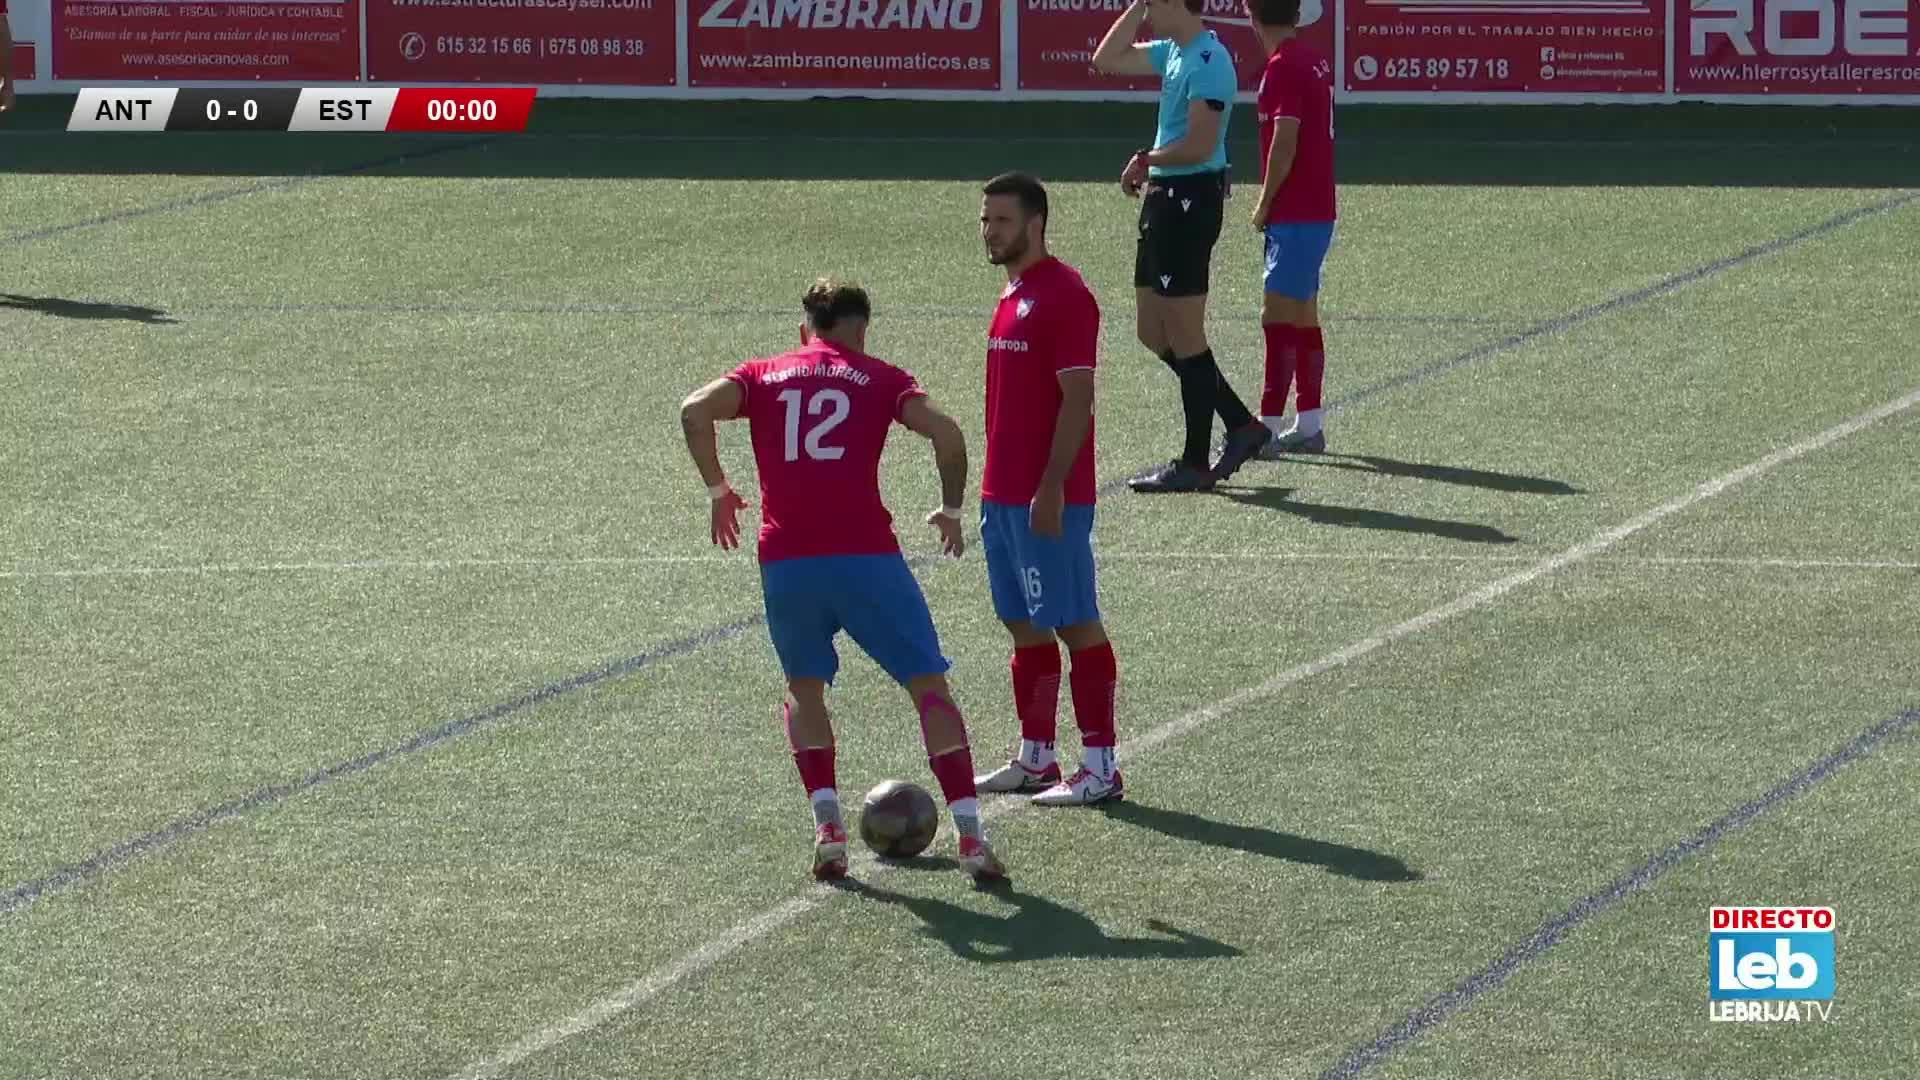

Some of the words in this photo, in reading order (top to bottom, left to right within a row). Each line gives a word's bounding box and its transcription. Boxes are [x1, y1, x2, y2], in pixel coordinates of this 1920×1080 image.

[698, 0, 984, 29] ZAMBRANO
[1421, 26, 1451, 36] POR
[1458, 26, 1477, 36] EL
[1482, 26, 1555, 37] TRABAJO
[1560, 26, 1596, 37] BIEN
[1602, 27, 1654, 37] HECHO
[1690, 0, 1920, 56] ROE
[437, 36, 464, 53] 615
[468, 37, 487, 54] 32
[491, 37, 509, 54] 15
[513, 38, 532, 54] 66
[549, 38, 577, 55] 675
[580, 38, 599, 55] 08
[603, 39, 621, 56] 98
[625, 39, 644, 56] 38
[699, 51, 991, 71] www.zambranoneumaticos.es
[1384, 57, 1421, 78] 625
[1425, 58, 1451, 78] 89
[1455, 58, 1480, 79] 57
[1485, 58, 1510, 79] 18
[814, 363, 871, 386] MORENO
[776, 388, 850, 462] 12
[1020, 567, 1043, 600] 16
